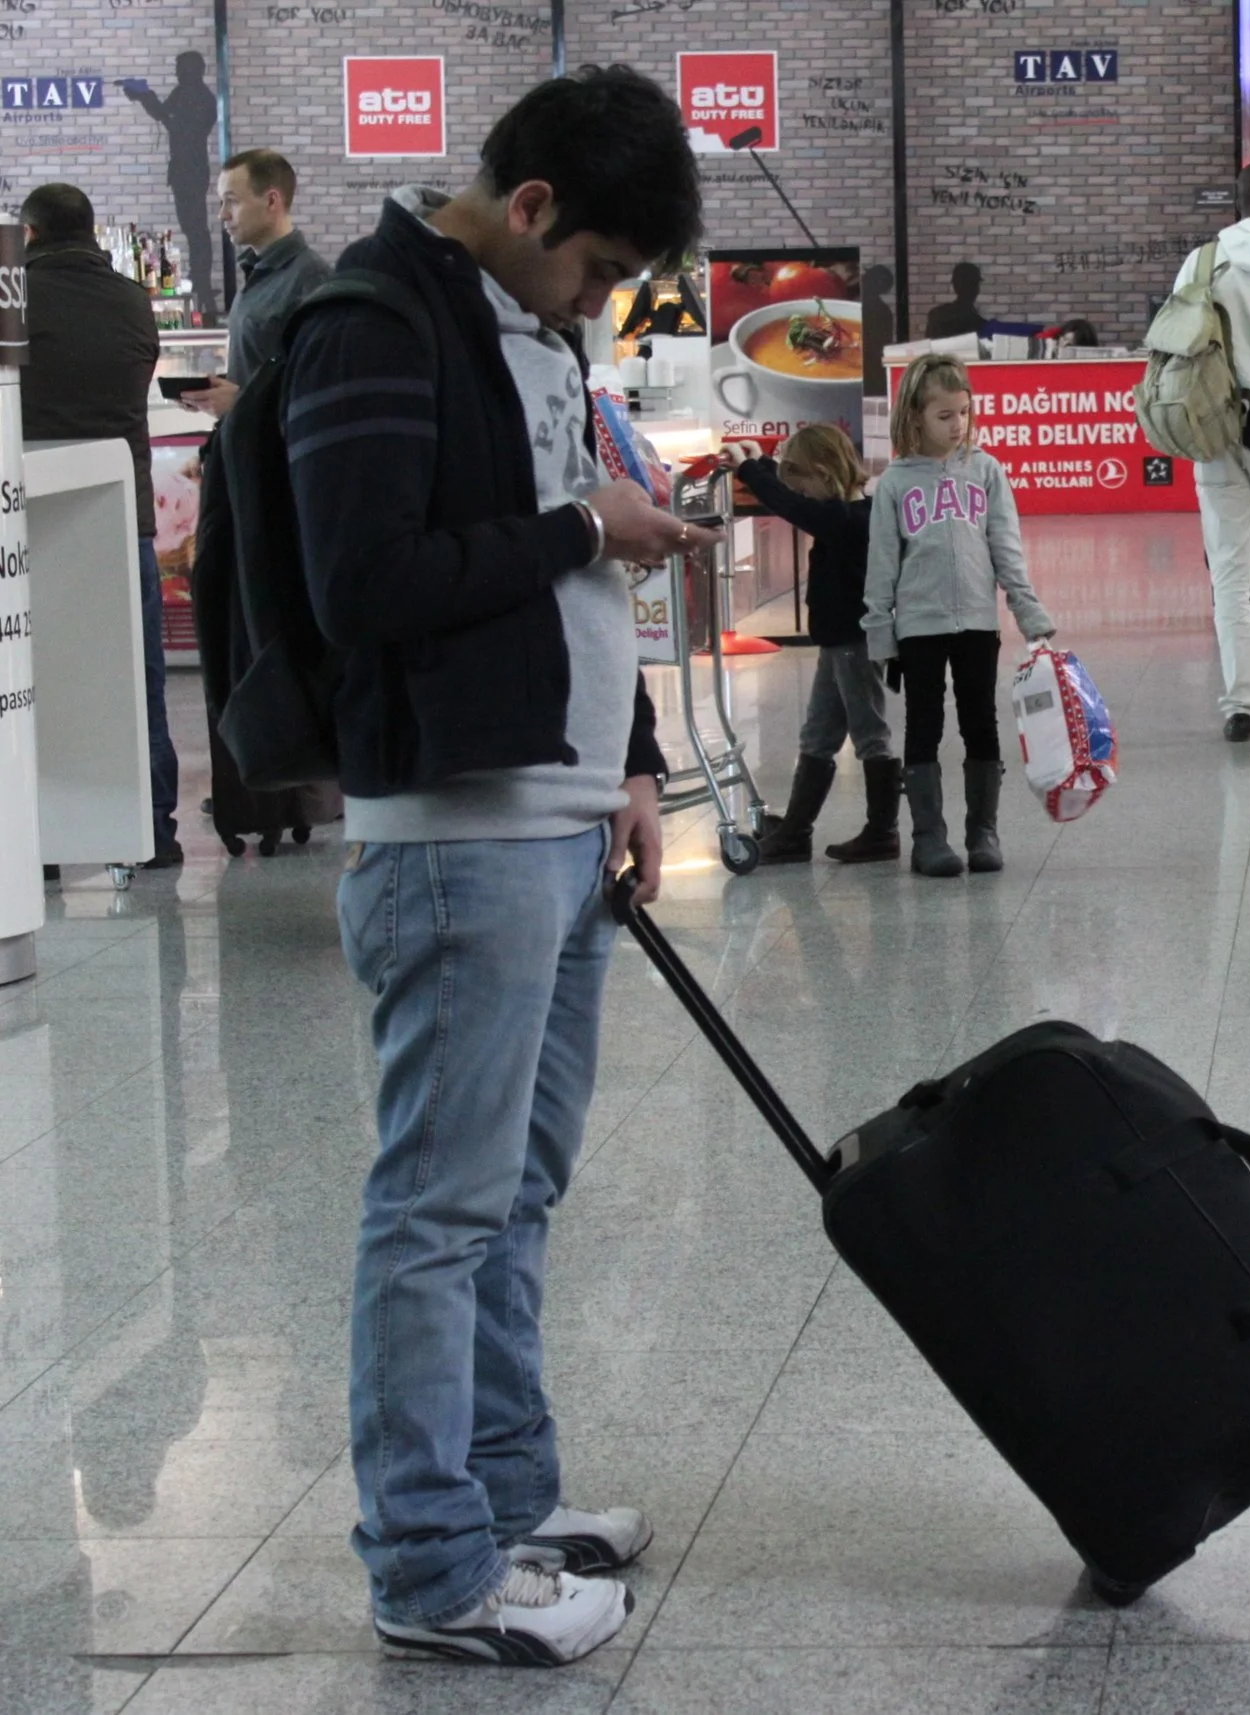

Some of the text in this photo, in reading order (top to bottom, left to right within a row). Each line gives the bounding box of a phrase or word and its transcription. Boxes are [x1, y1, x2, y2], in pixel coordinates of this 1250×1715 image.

[311, 7, 347, 24] YOU
[1019, 55, 1112, 80] TAV
[8, 81, 97, 107] TAV
[1014, 84, 1077, 96] Airports
[3, 111, 64, 124] Airports
[358, 114, 431, 125] DUTY FREE
[691, 109, 765, 120] DUTY FREE
[1002, 387, 1098, 416] DAĞITIM
[723, 418, 757, 437] Şefin
[762, 420, 790, 437] en
[1038, 423, 1139, 445] DELIVERY
[1020, 460, 1093, 473] AIRLINES
[1034, 474, 1094, 489] YOLLARI
[900, 477, 988, 536] GAP
